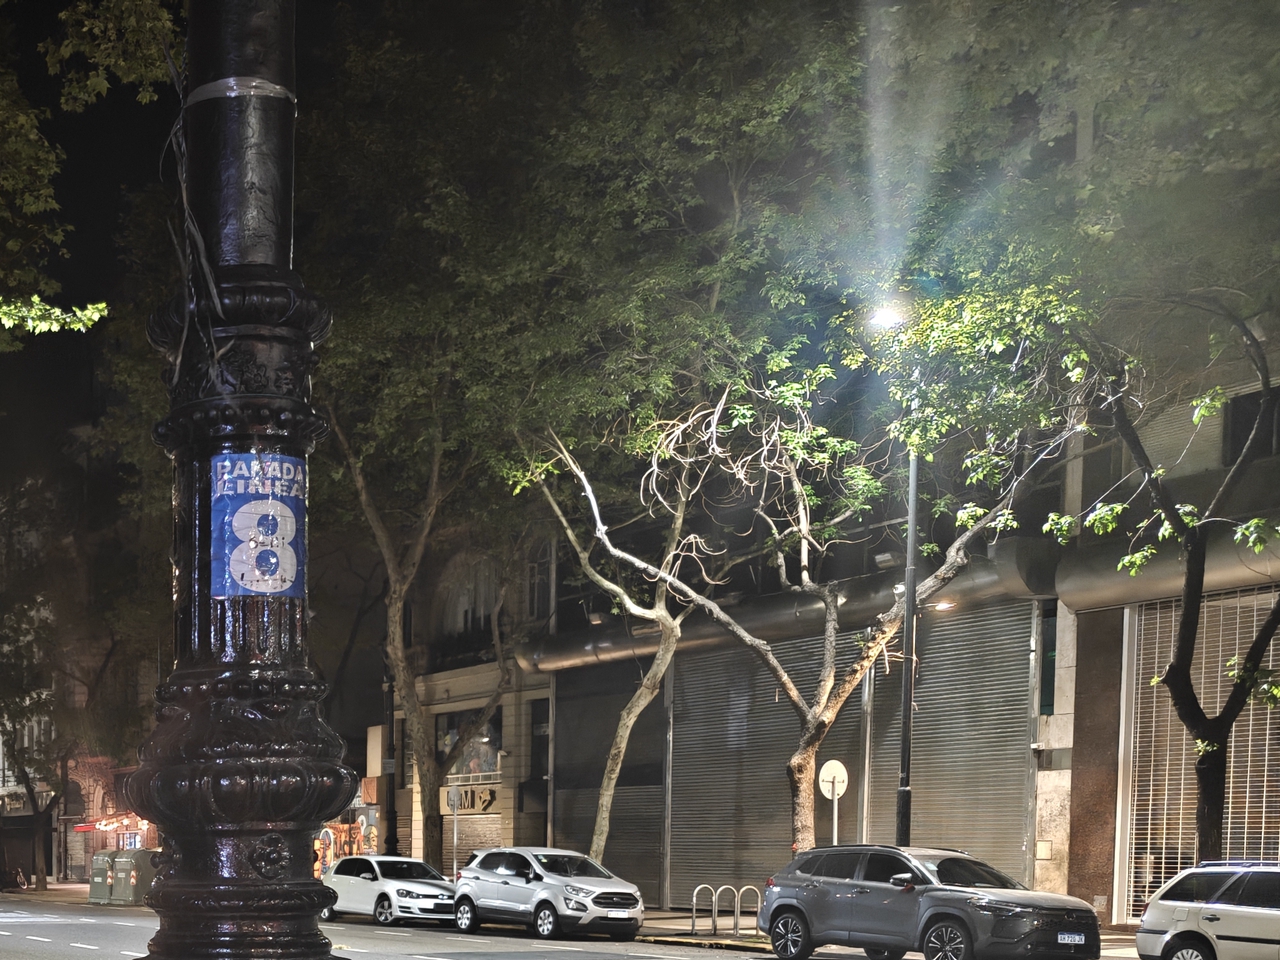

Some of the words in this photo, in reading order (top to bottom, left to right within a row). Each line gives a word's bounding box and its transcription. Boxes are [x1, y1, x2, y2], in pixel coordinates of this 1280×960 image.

[216, 461, 304, 482] PARADA
[216, 479, 304, 498] LINEA
[230, 500, 297, 593] 8
